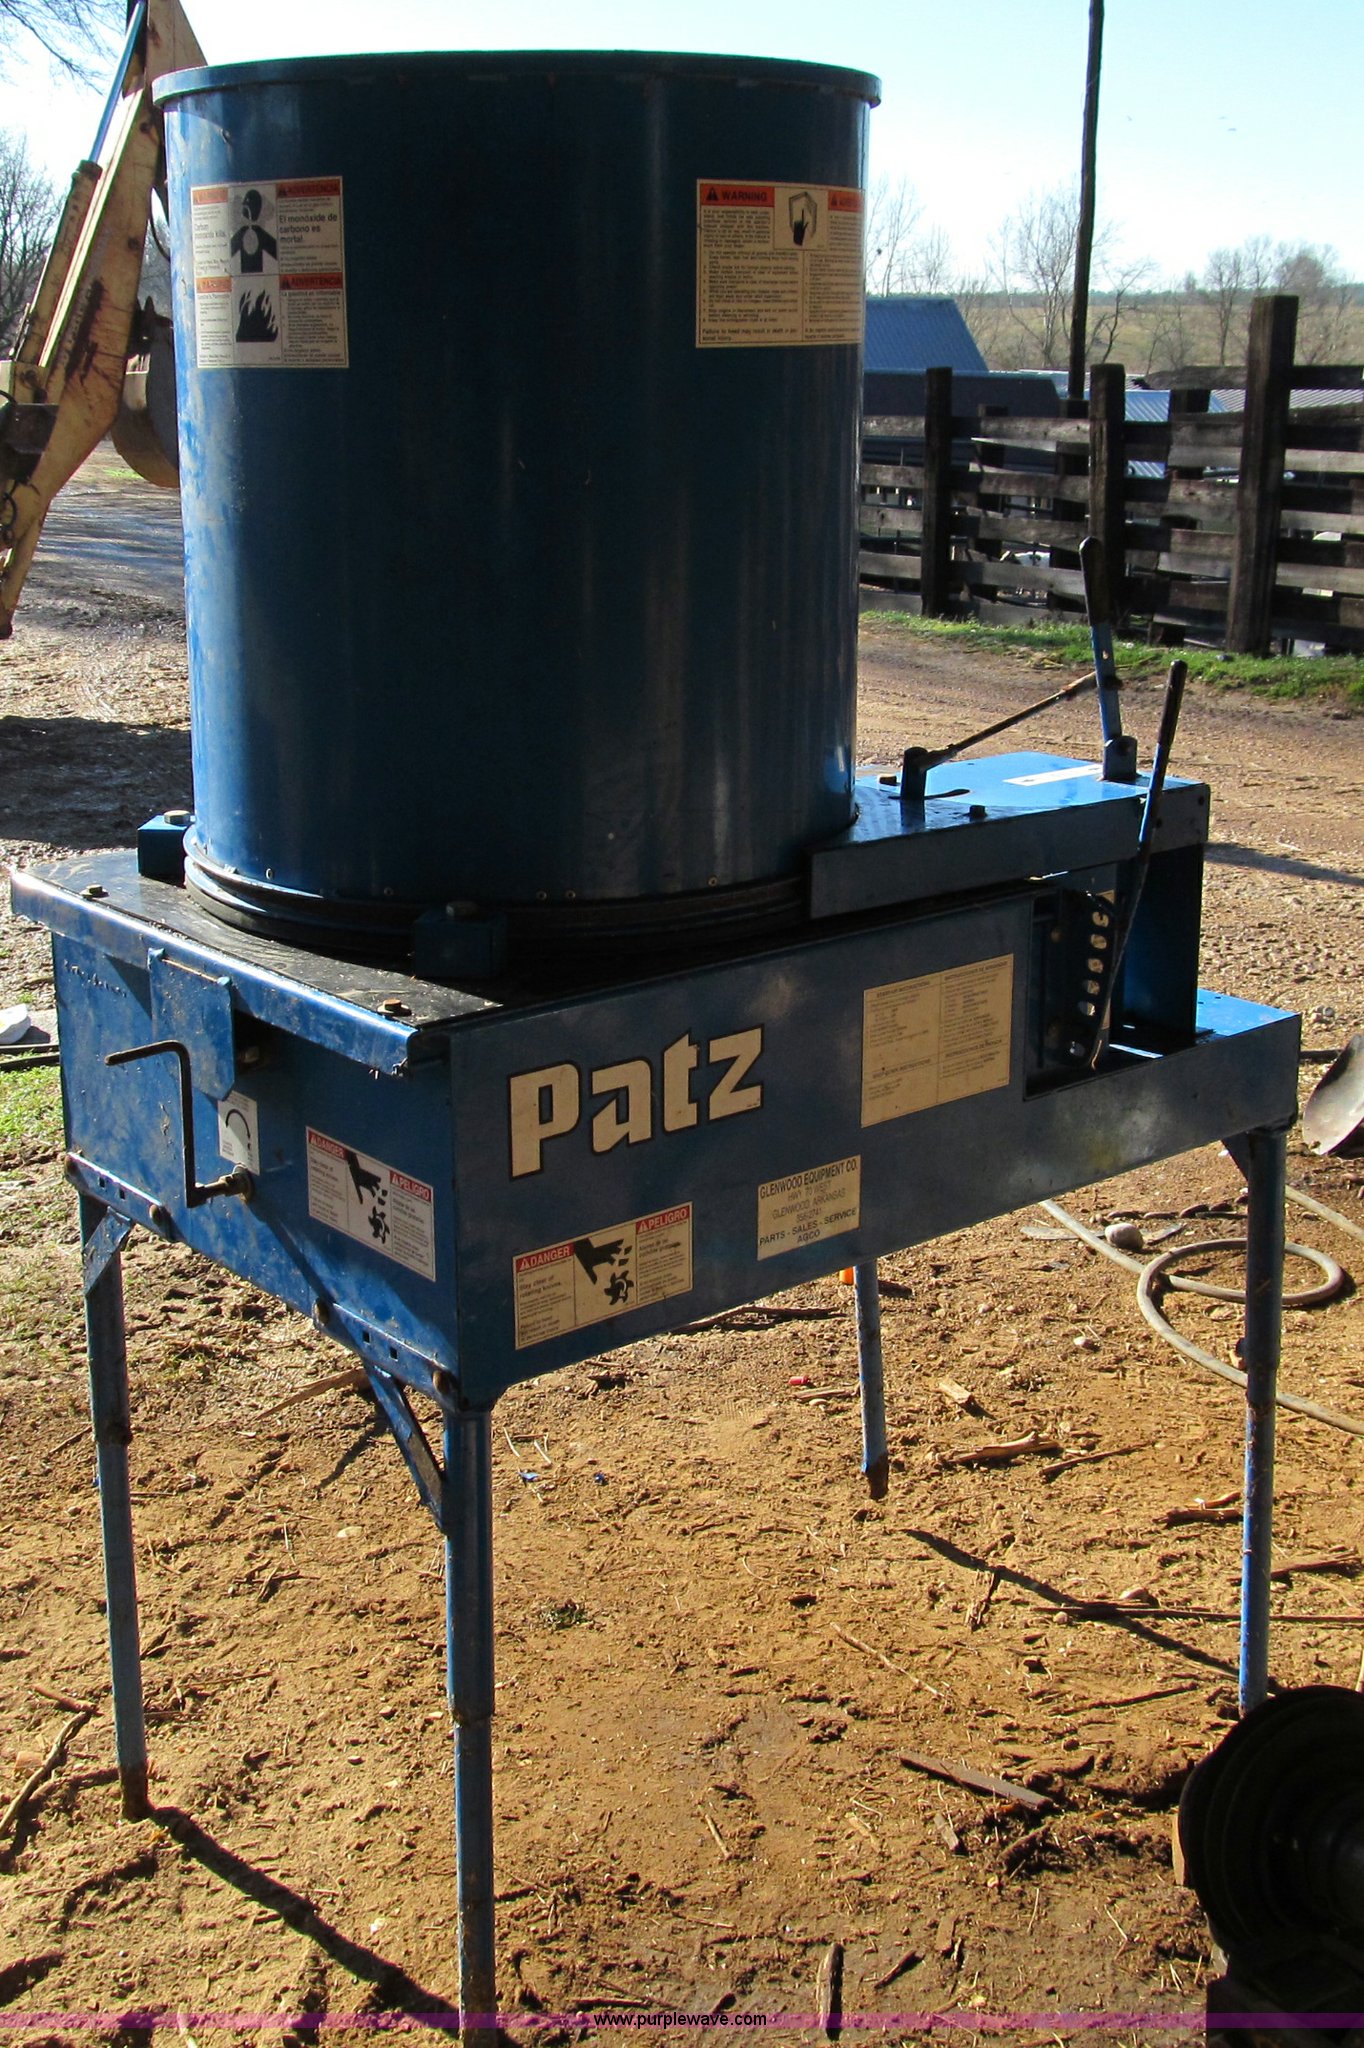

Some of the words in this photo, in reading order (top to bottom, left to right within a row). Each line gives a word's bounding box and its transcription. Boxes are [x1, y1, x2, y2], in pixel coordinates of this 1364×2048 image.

[721, 190, 768, 201] WARNING
[329, 213, 338, 222] de
[760, 1176, 802, 1199] GLENWOOD
[803, 1161, 844, 1186] EQUIPMENT
[648, 1207, 688, 1230] PELIGRO
[759, 1230, 786, 1246] PARTS
[792, 1220, 818, 1236] SALES
[824, 1207, 858, 1225] SERVICE
[796, 1228, 821, 1244] AGCO
[529, 1245, 571, 1269] DANGER
